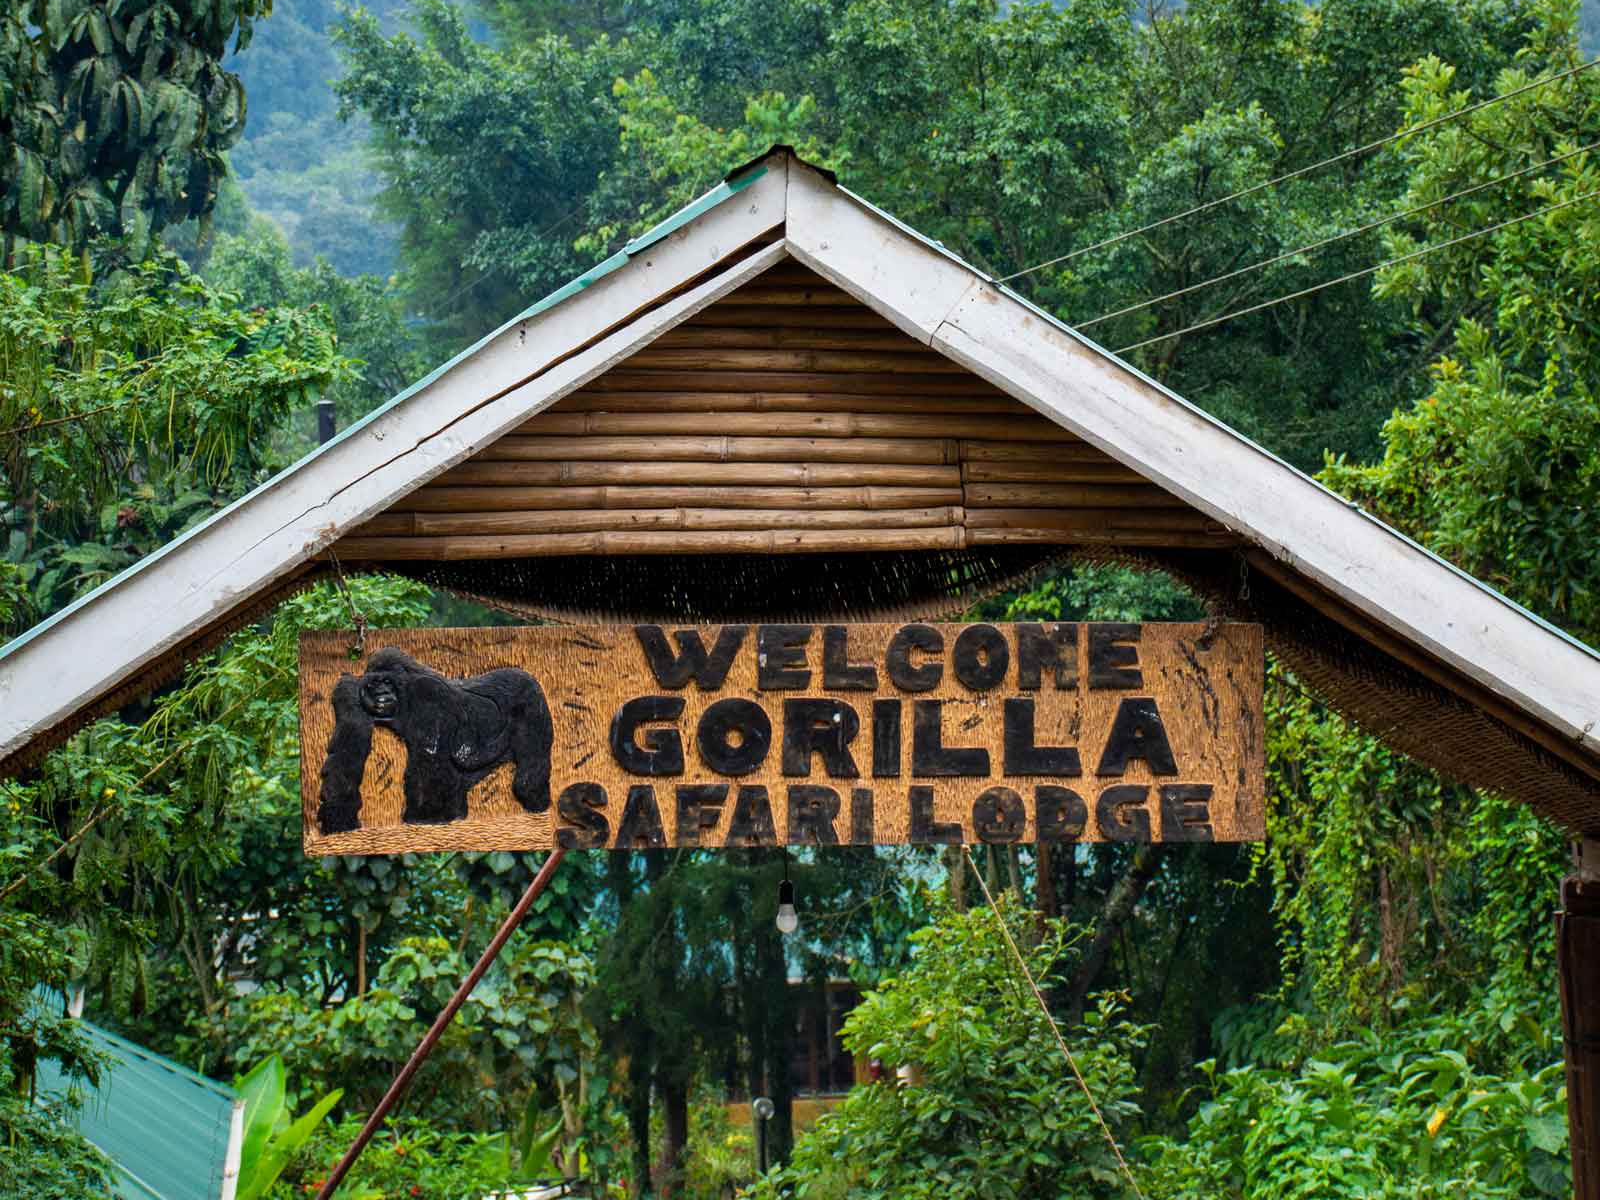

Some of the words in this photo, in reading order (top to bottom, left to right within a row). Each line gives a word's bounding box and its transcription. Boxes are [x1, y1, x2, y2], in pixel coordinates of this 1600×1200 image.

[634, 623, 1143, 692] WELCOME
[610, 696, 1178, 777] GORILLA
[556, 783, 875, 849] SAFARI
[908, 784, 1214, 844] LODGE
